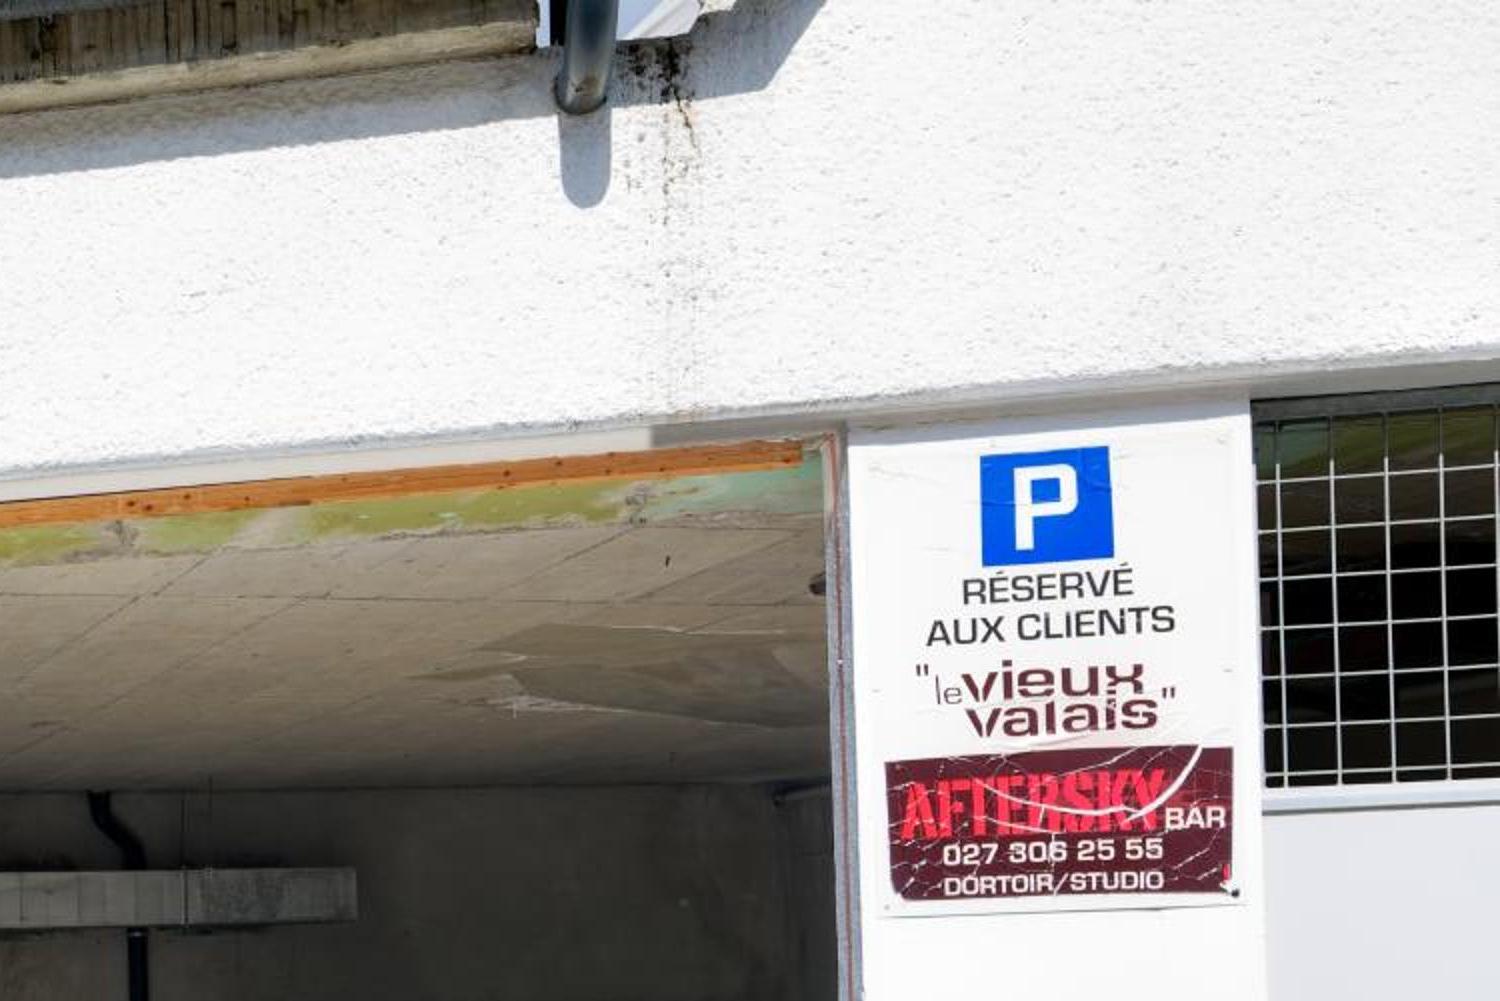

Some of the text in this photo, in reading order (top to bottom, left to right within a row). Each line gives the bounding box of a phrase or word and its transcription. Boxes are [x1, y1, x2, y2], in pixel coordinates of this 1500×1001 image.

[1013, 463, 1079, 551] P
[962, 562, 1134, 605] RÉSERVÉ
[926, 605, 1176, 647] AUX CLIENTS
[900, 769, 1226, 840] AFTERSKY BAR
[943, 837, 1164, 867] 027 306 25 55
[943, 870, 1165, 897] DORTOIR/STUDIO
